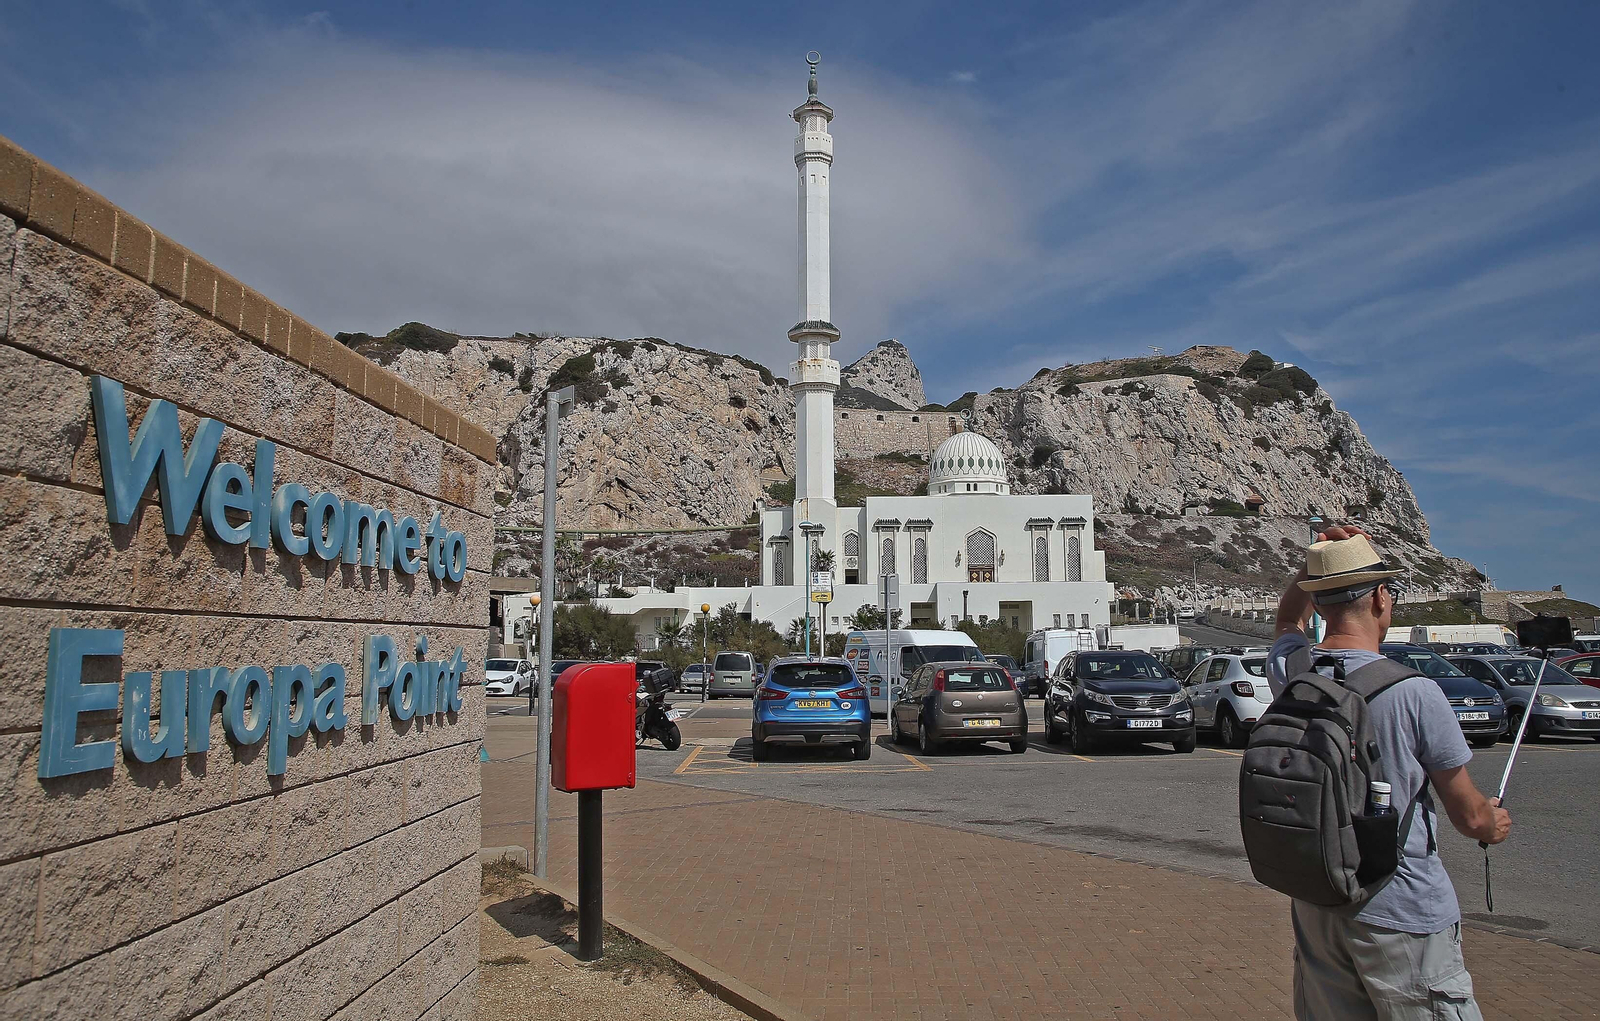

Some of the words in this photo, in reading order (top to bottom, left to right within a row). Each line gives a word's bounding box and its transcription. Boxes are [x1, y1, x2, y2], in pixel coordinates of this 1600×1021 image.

[91, 375, 421, 575] Welcome
[425, 510, 467, 583] to
[38, 628, 348, 779] Europa
[362, 635, 467, 726] Point
